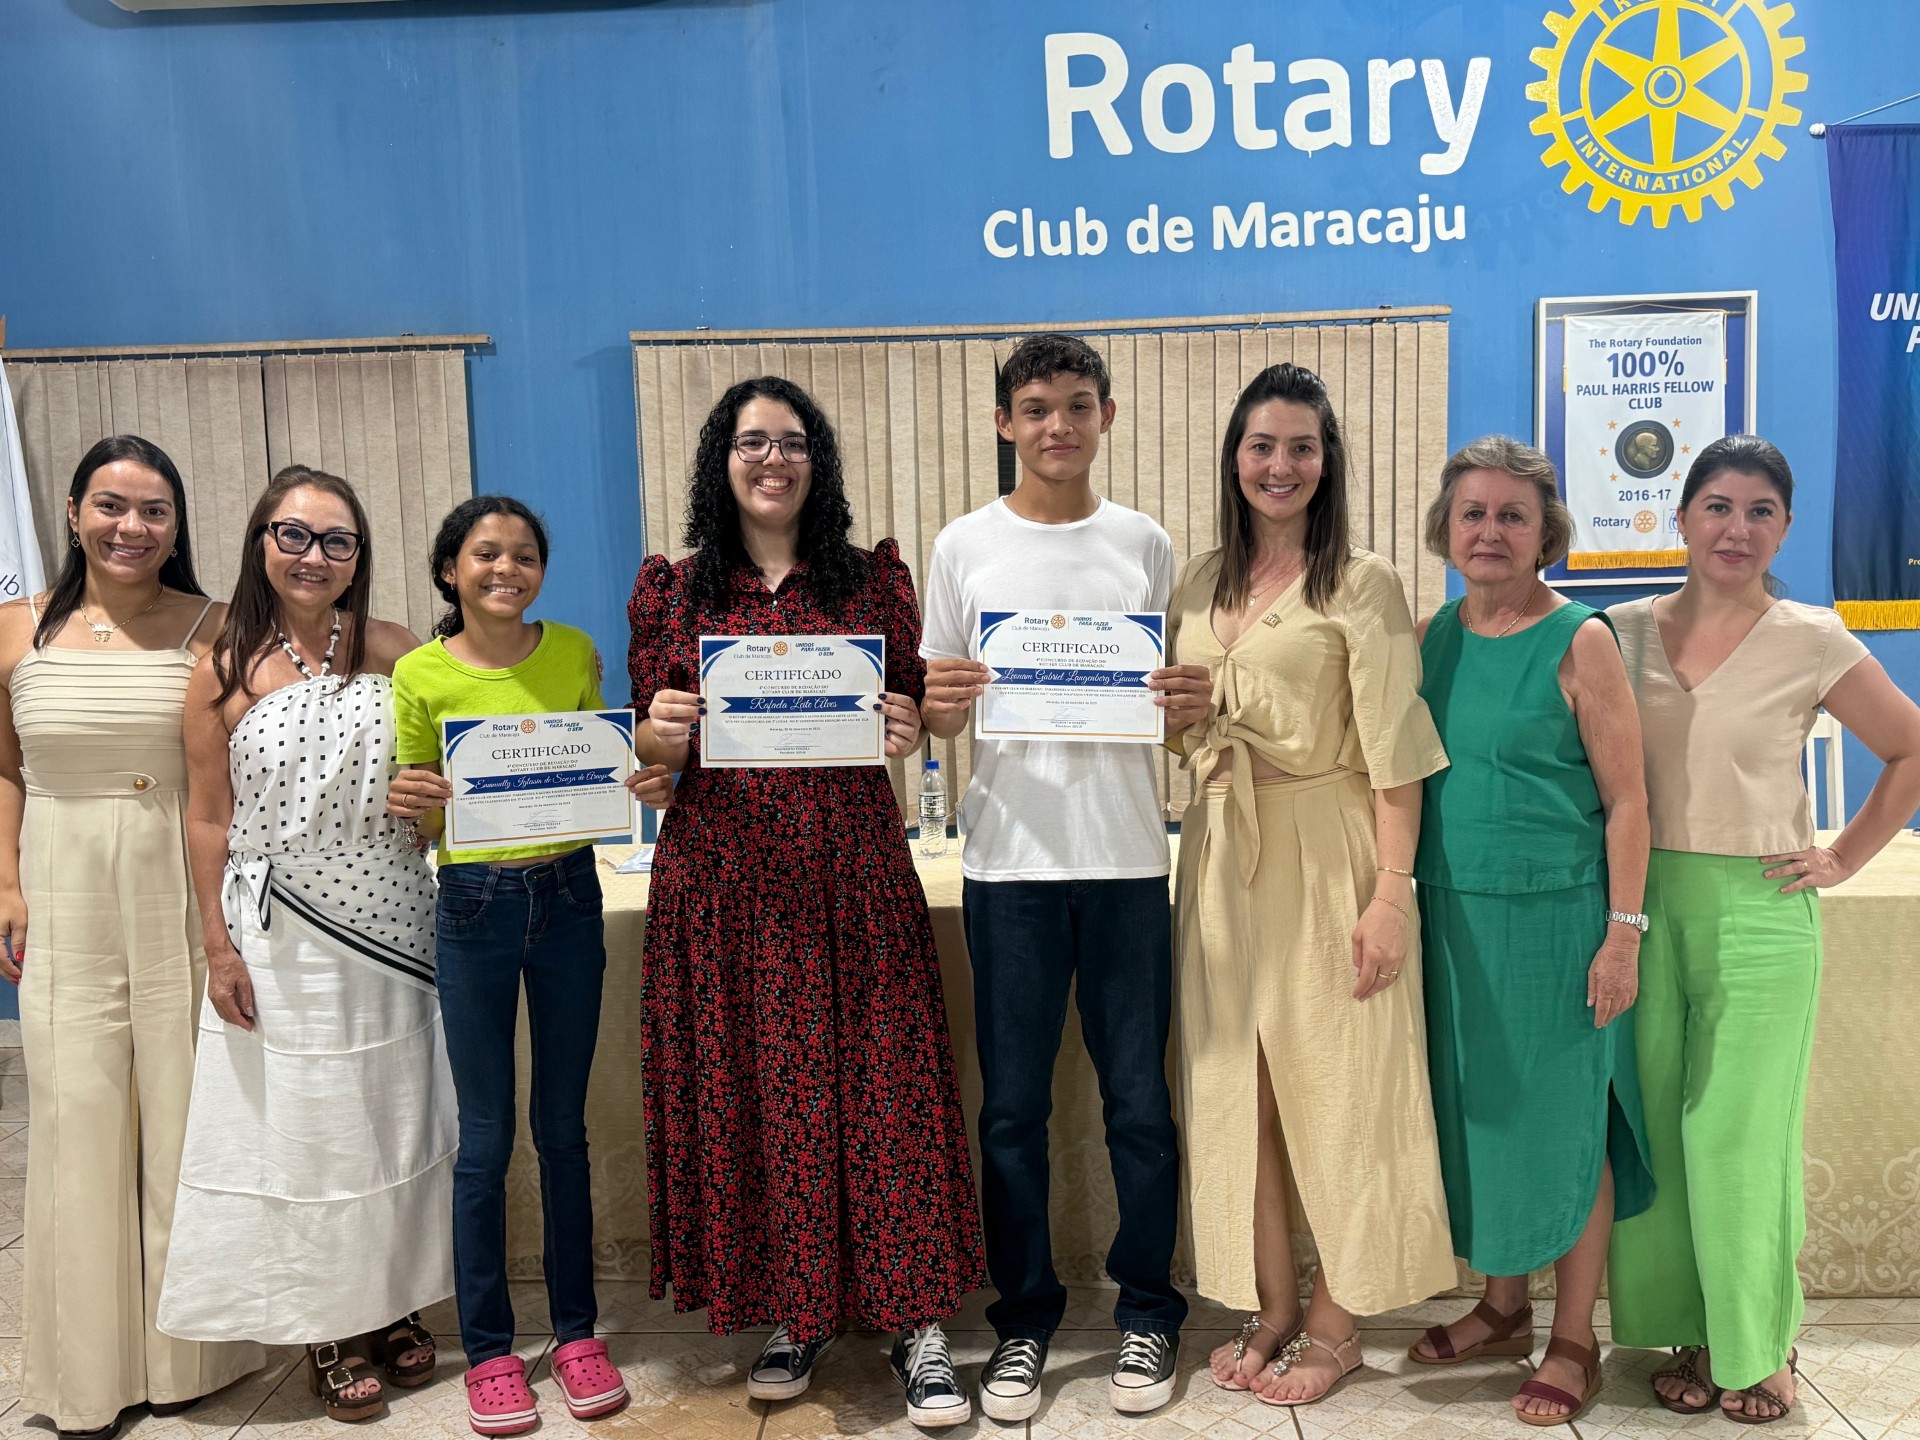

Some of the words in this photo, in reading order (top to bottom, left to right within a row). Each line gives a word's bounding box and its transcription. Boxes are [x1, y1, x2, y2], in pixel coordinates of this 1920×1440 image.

[1044, 32, 1491, 175] Rotary
[1575, 133, 1750, 192] INTERNATIONAL
[983, 207, 1108, 258] Club
[1126, 204, 1194, 254] de
[1213, 193, 1467, 253] Maracaju
[1870, 292, 1920, 321] UN
[1589, 339, 1607, 349] The
[1610, 338, 1642, 349] Rotary
[1646, 336, 1702, 347] Foundation
[1606, 349, 1685, 378] 100%
[1576, 384, 1608, 396] PAUL
[1612, 382, 1660, 395] HARRIS
[1664, 380, 1714, 393] FELLOW
[1628, 397, 1662, 410] CLUB
[1618, 489, 1671, 502] 2016-17
[1593, 517, 1631, 530] Rotary
[1024, 617, 1049, 626] Rotary
[746, 645, 771, 654] Rotary
[1022, 642, 1120, 655] CERTIFICADO
[744, 669, 842, 681] CERTIFICADO
[1034, 668, 1064, 684] Gabriel
[750, 698, 788, 713] Rafaela
[790, 696, 812, 712] Leite
[814, 697, 838, 709] Alves
[492, 744, 591, 760] CERTIFICADO
